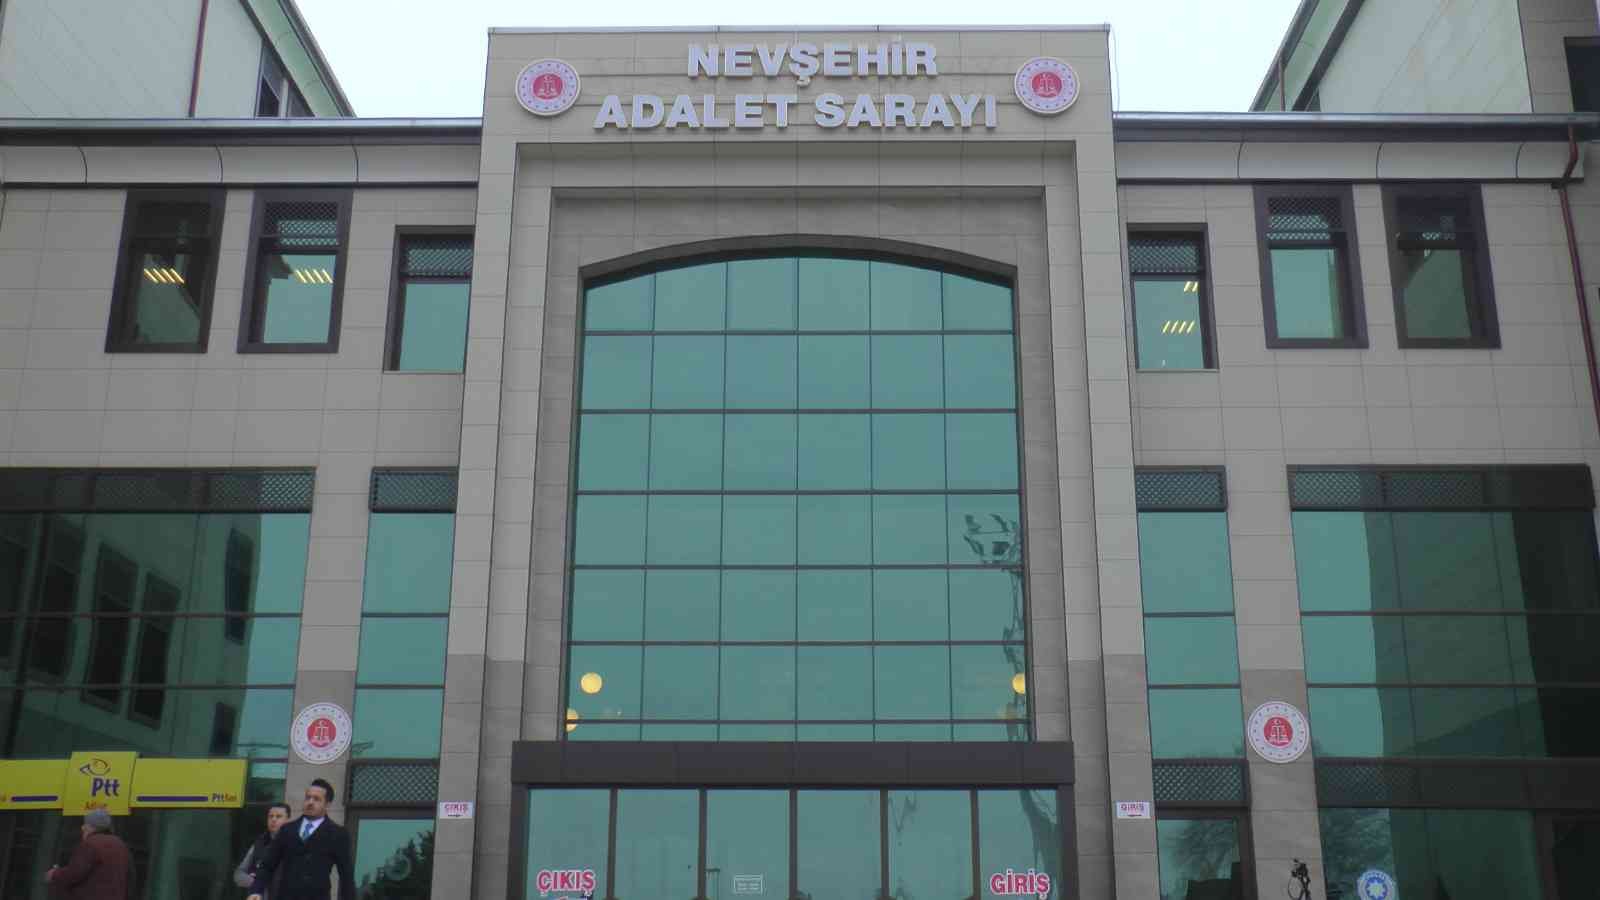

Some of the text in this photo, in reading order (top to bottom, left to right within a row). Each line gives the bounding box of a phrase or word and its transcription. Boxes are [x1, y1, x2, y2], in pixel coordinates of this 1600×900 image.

[687, 35, 938, 86] NEVŞEHİR
[593, 92, 997, 130] ADALET SARAYI
[91, 777, 120, 798] Ptt
[536, 869, 595, 897] ÇIKIŞ
[990, 868, 1050, 900] GİRİŞ
